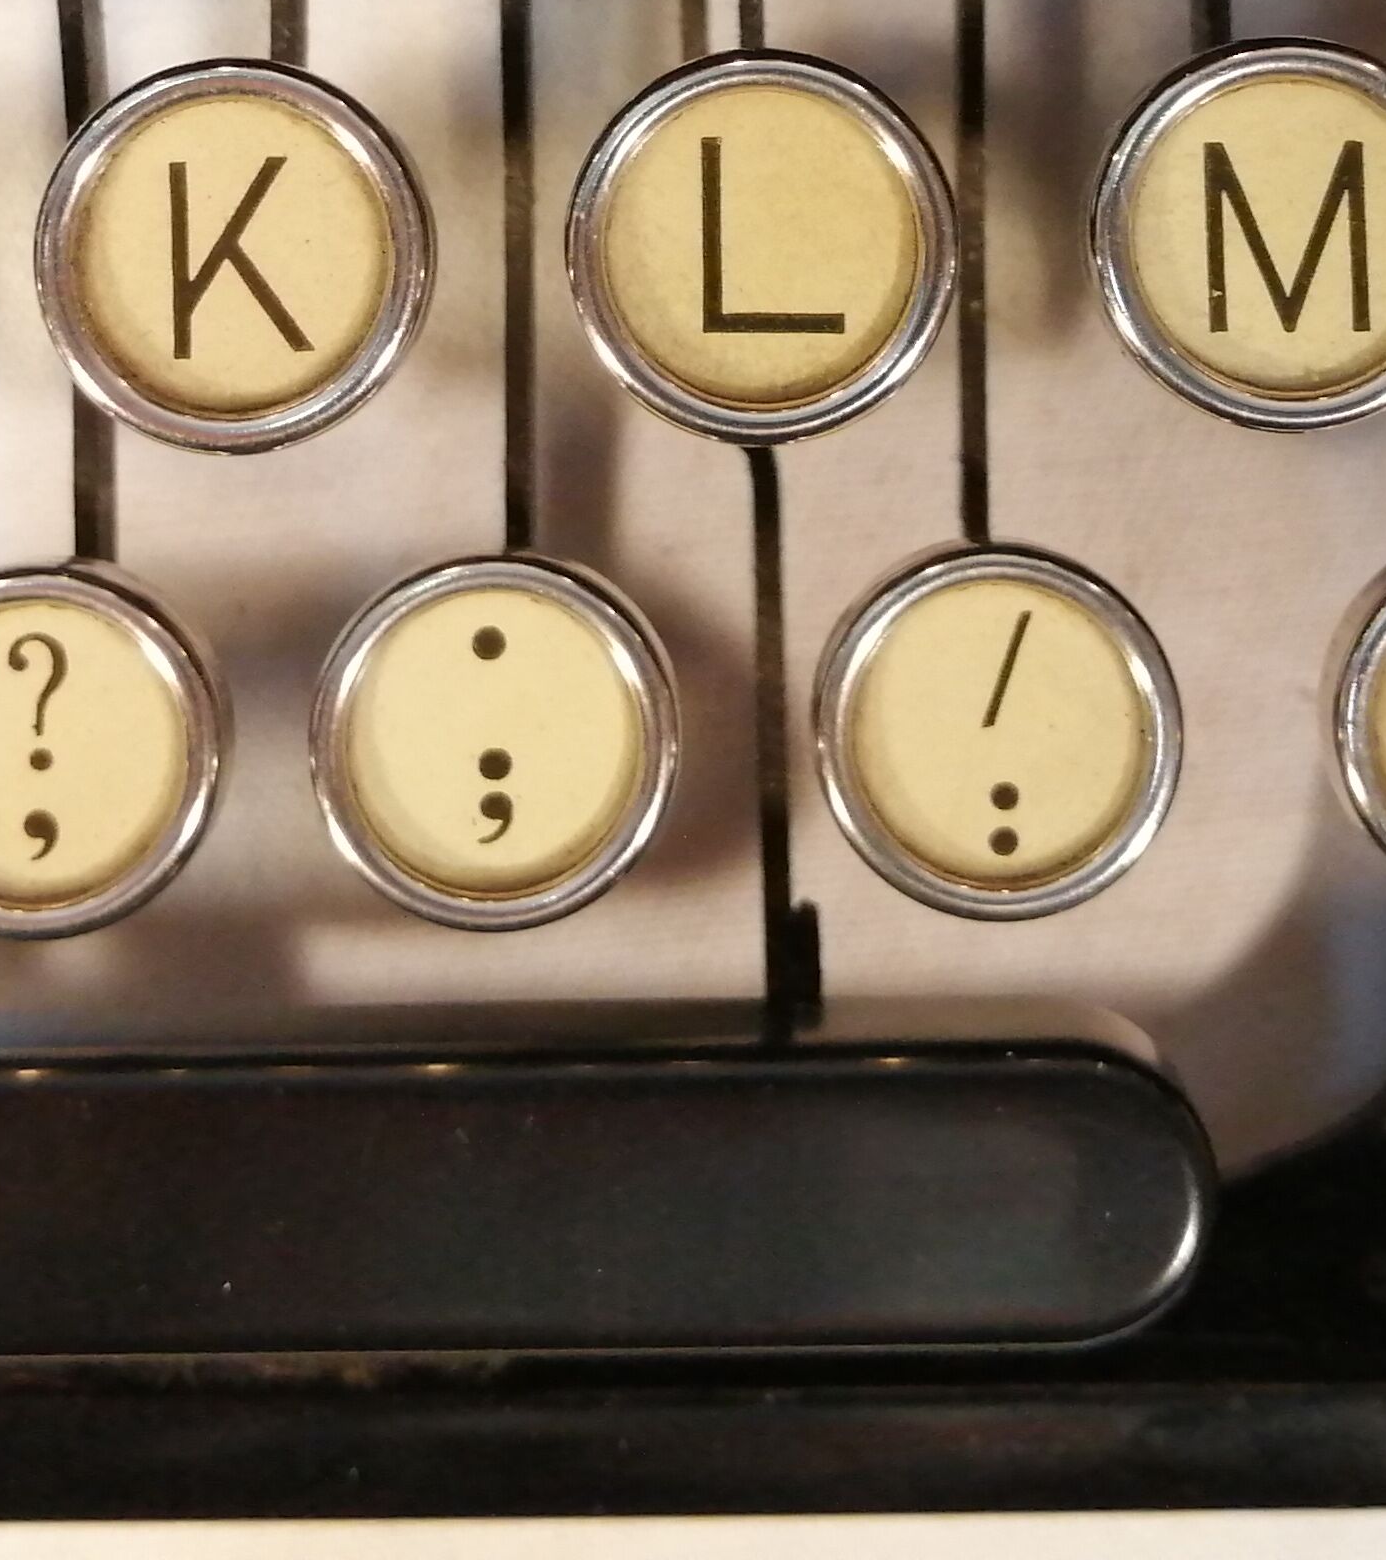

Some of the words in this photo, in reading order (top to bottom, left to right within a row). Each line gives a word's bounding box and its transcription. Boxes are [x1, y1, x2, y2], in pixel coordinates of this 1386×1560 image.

[168, 156, 315, 360] K
[700, 136, 846, 335] L
[1203, 140, 1372, 334] M
[7, 632, 68, 772] ?
